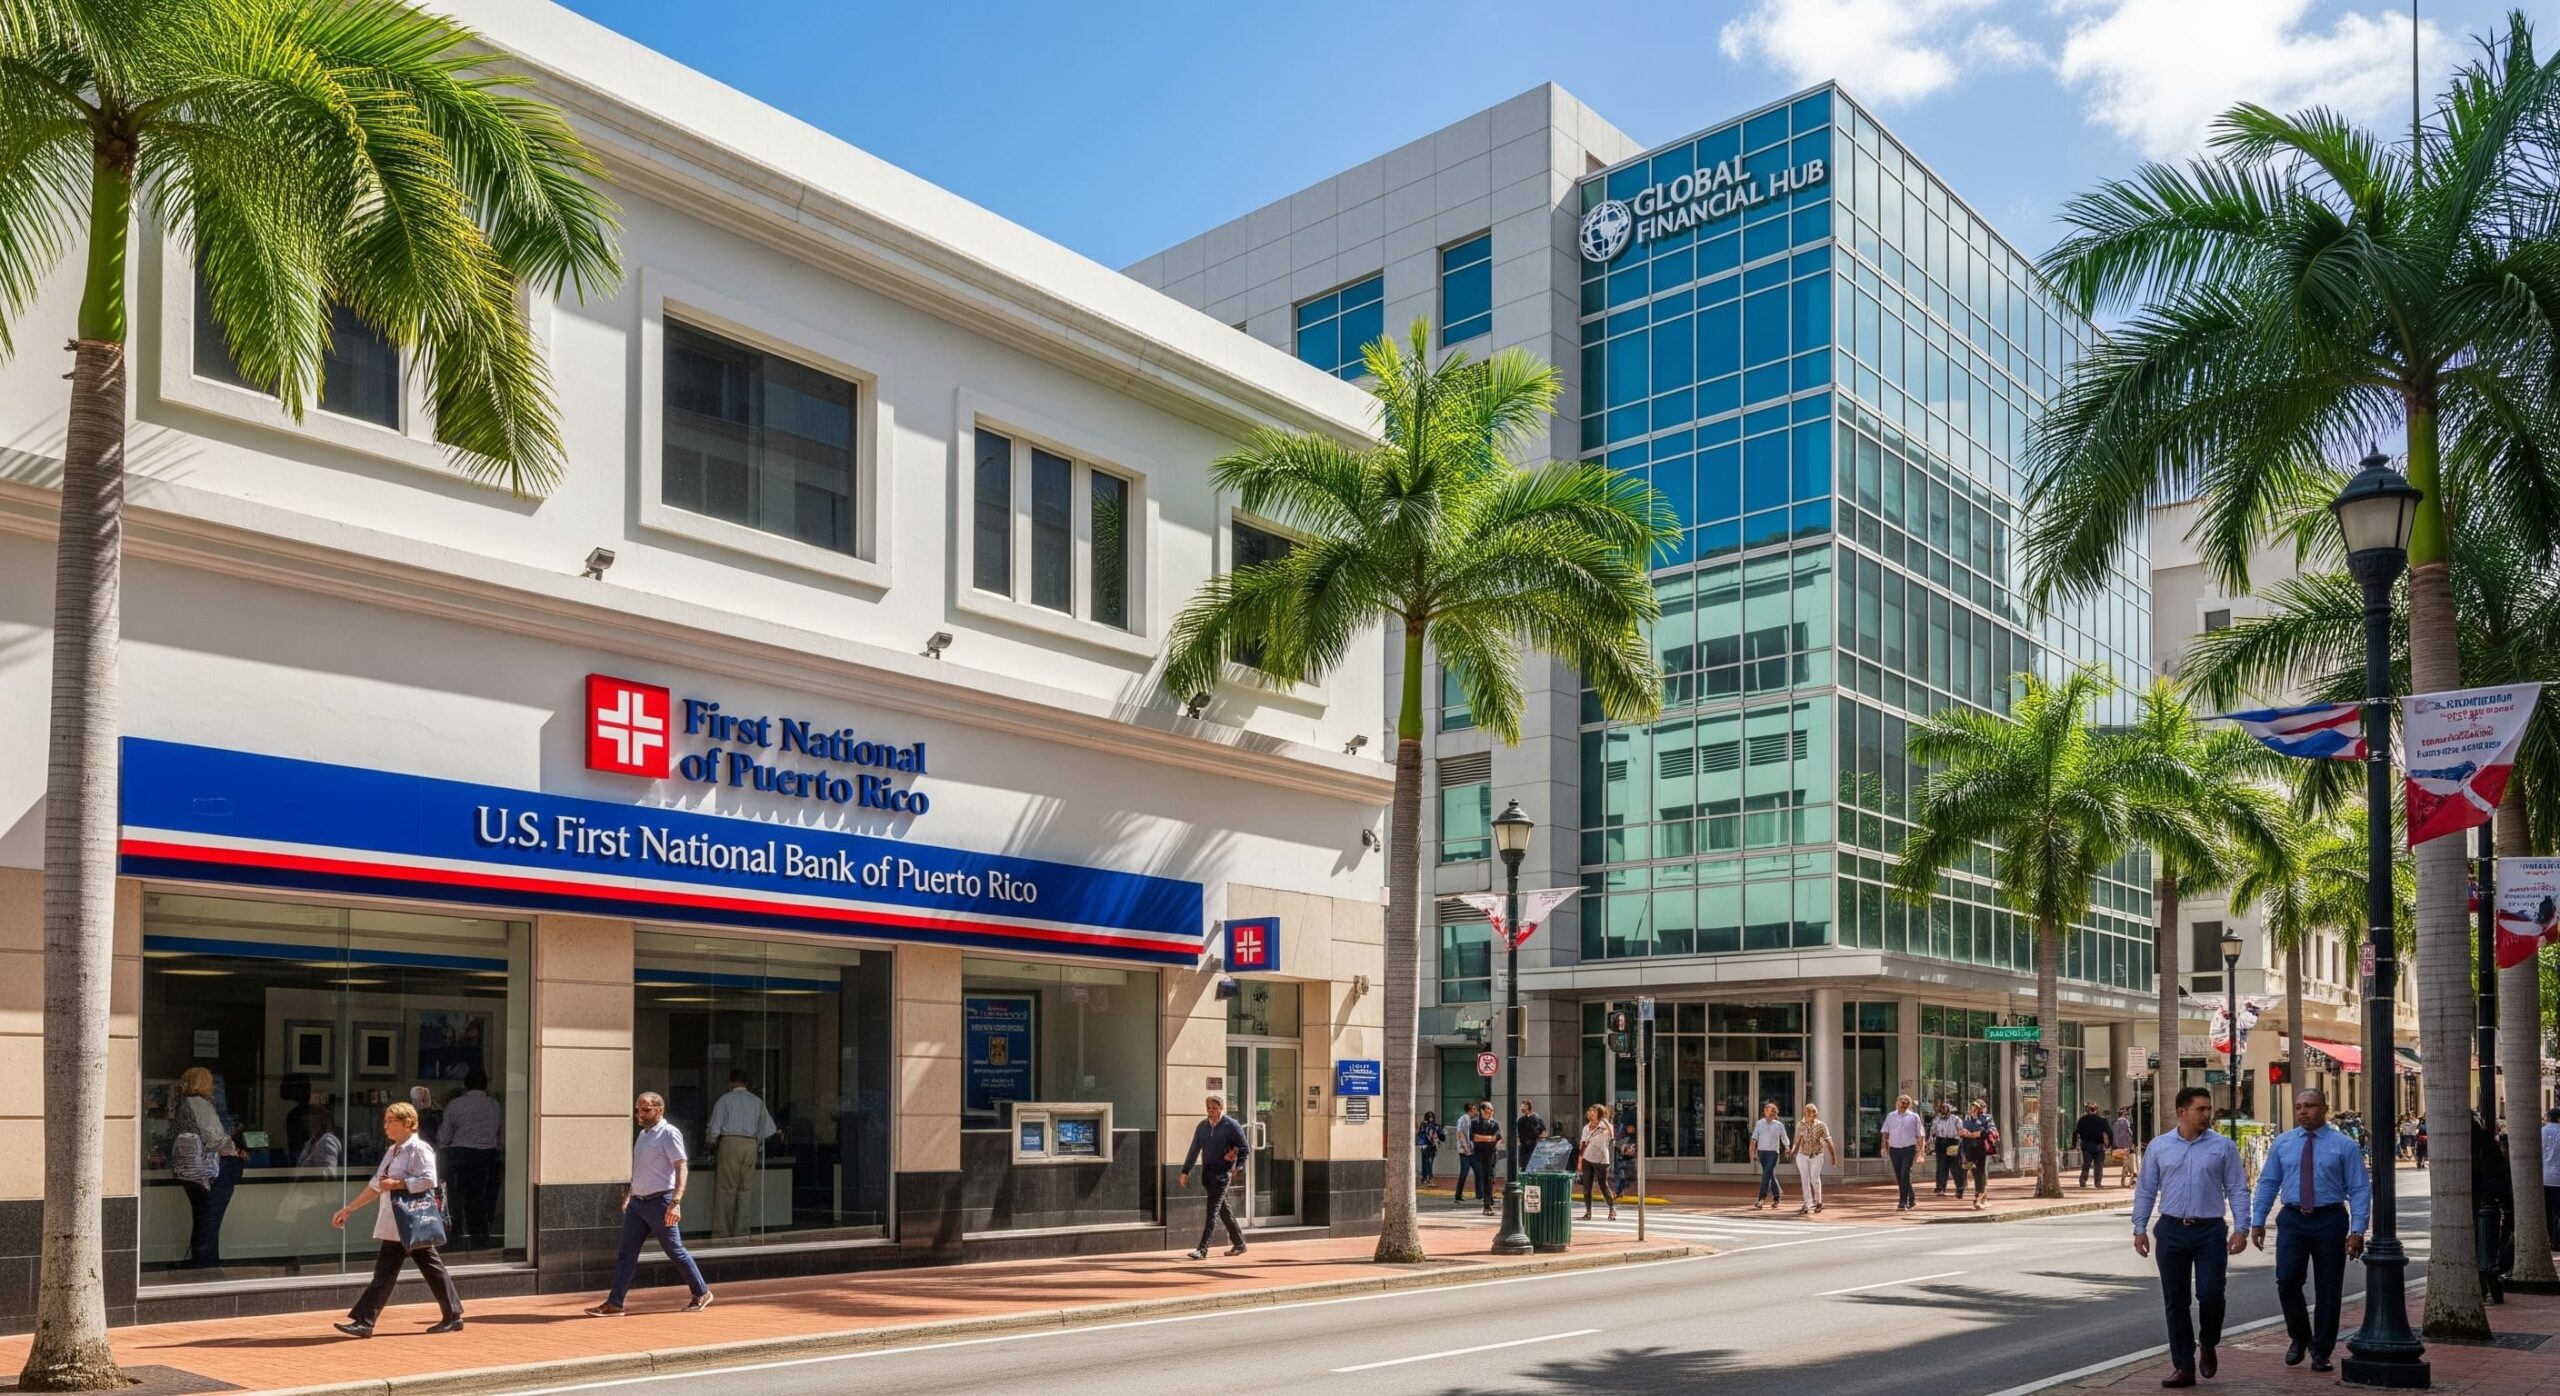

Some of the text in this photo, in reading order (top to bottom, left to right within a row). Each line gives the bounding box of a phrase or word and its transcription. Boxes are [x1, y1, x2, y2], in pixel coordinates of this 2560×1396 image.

[1633, 154, 1751, 217] GLOBAL
[1637, 158, 1825, 244] FINANCIAL HUB
[681, 698, 928, 775] First National
[680, 748, 930, 815] of Puerto Rico
[479, 806, 1038, 903] U.S. First National Bank of Puerto Rico
